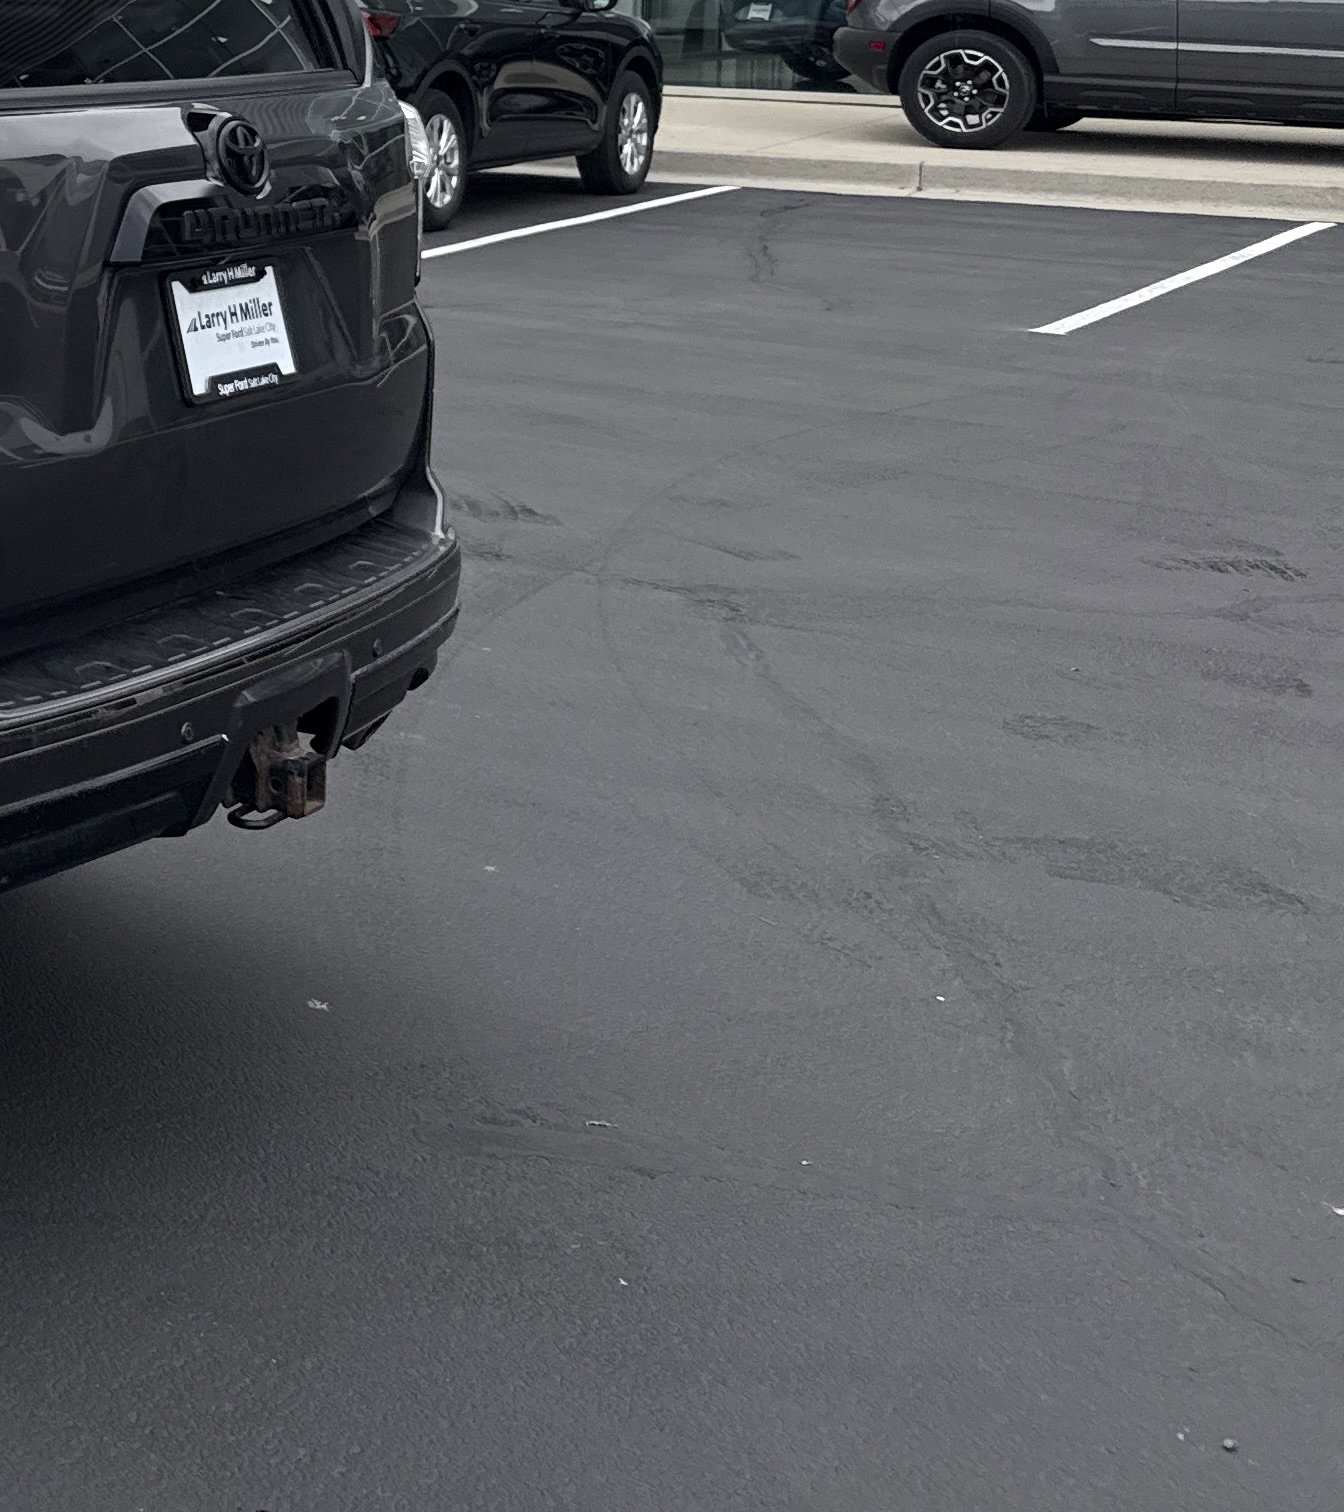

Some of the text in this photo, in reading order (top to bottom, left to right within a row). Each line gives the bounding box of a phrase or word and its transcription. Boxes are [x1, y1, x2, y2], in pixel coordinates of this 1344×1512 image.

[207, 271, 228, 284] Larry
[234, 263, 256, 279] Miller
[197, 297, 273, 330] Larry H Miller
